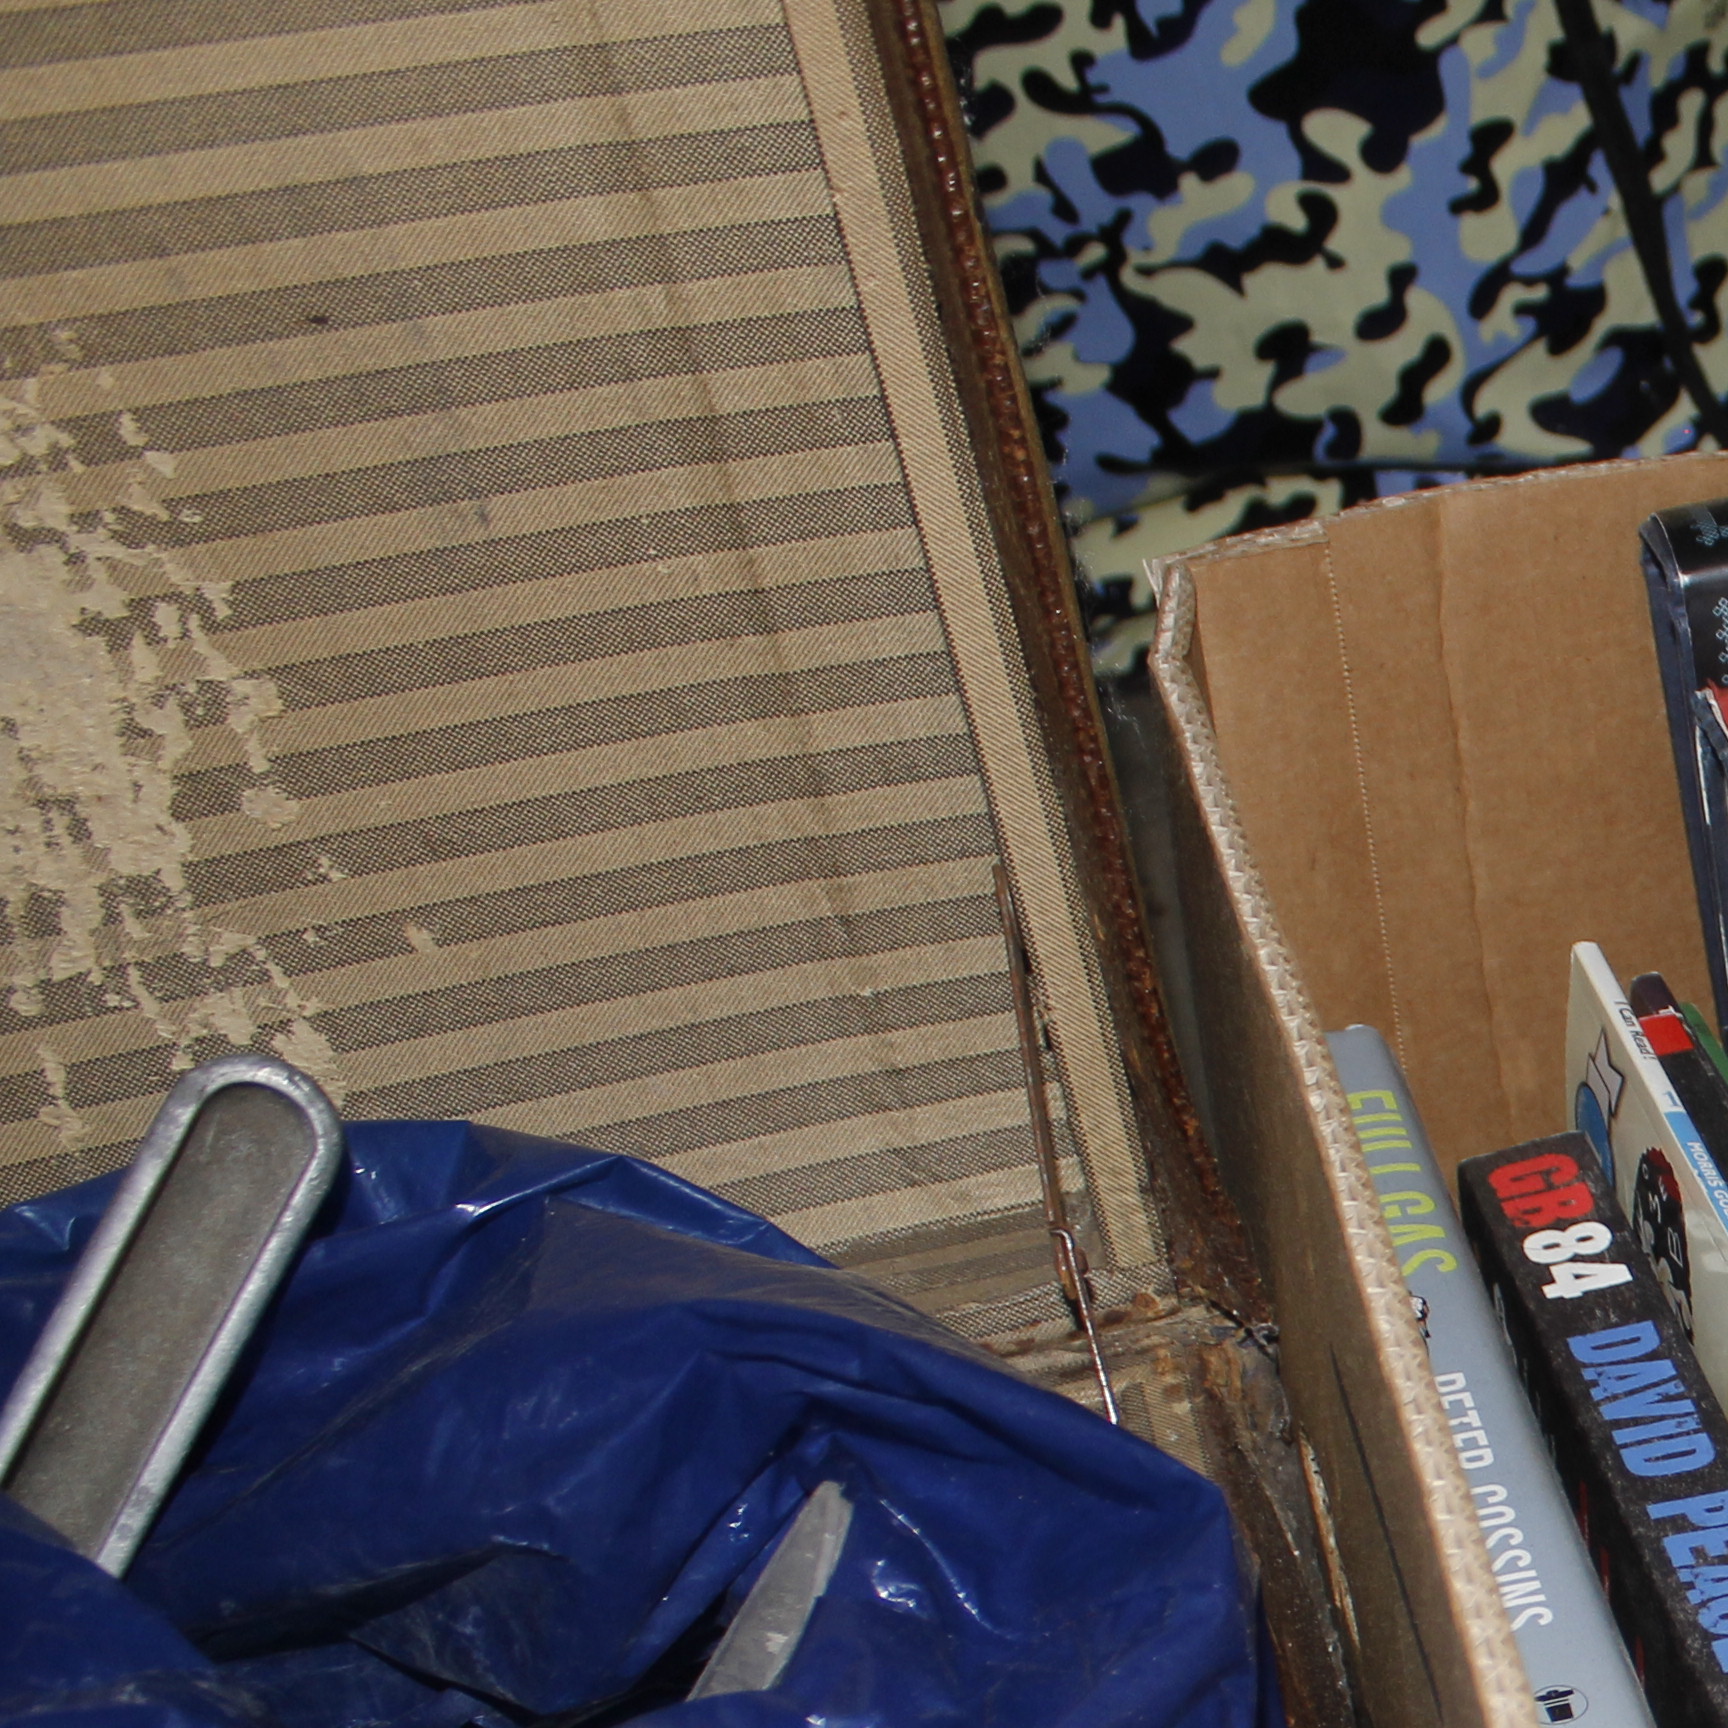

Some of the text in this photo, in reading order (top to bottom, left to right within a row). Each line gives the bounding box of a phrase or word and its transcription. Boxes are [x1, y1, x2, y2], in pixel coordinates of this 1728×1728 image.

[1617, 1006, 1638, 1034] Can
[1686, 1141, 1724, 1188] MORRIS
[1486, 1149, 1637, 1302] GB84
[1565, 1319, 1717, 1477] DAVID
